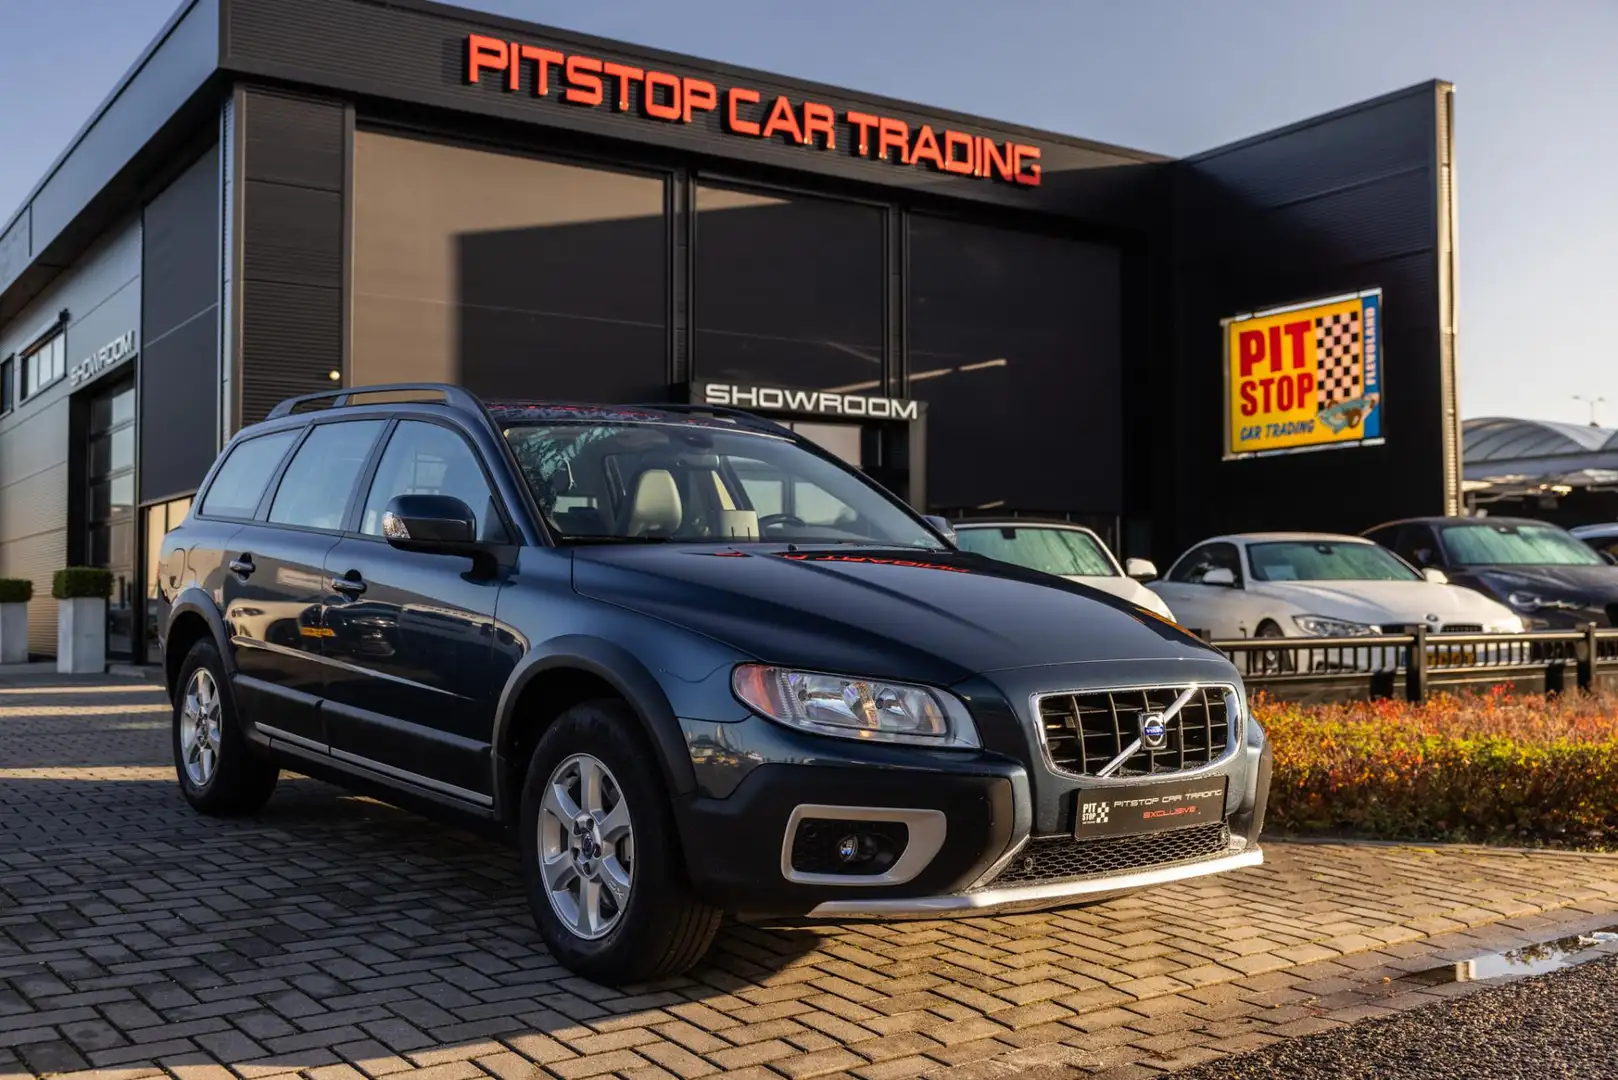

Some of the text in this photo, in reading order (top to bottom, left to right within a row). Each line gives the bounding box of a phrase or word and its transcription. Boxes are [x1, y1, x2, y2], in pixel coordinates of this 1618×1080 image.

[468, 34, 1041, 186] PITSTOP CAR TRADING
[1239, 320, 1312, 377] PIT
[705, 383, 918, 419] SHOWROOM
[1240, 372, 1314, 416] STOP
[1240, 419, 1315, 441] CAR TRADING
[1082, 802, 1097, 813] PIT
[1113, 797, 1160, 808] PITSTOP
[1161, 794, 1183, 803] CAR
[1143, 805, 1197, 819] EXCLUSIVE
[1082, 813, 1096, 821] STOP
